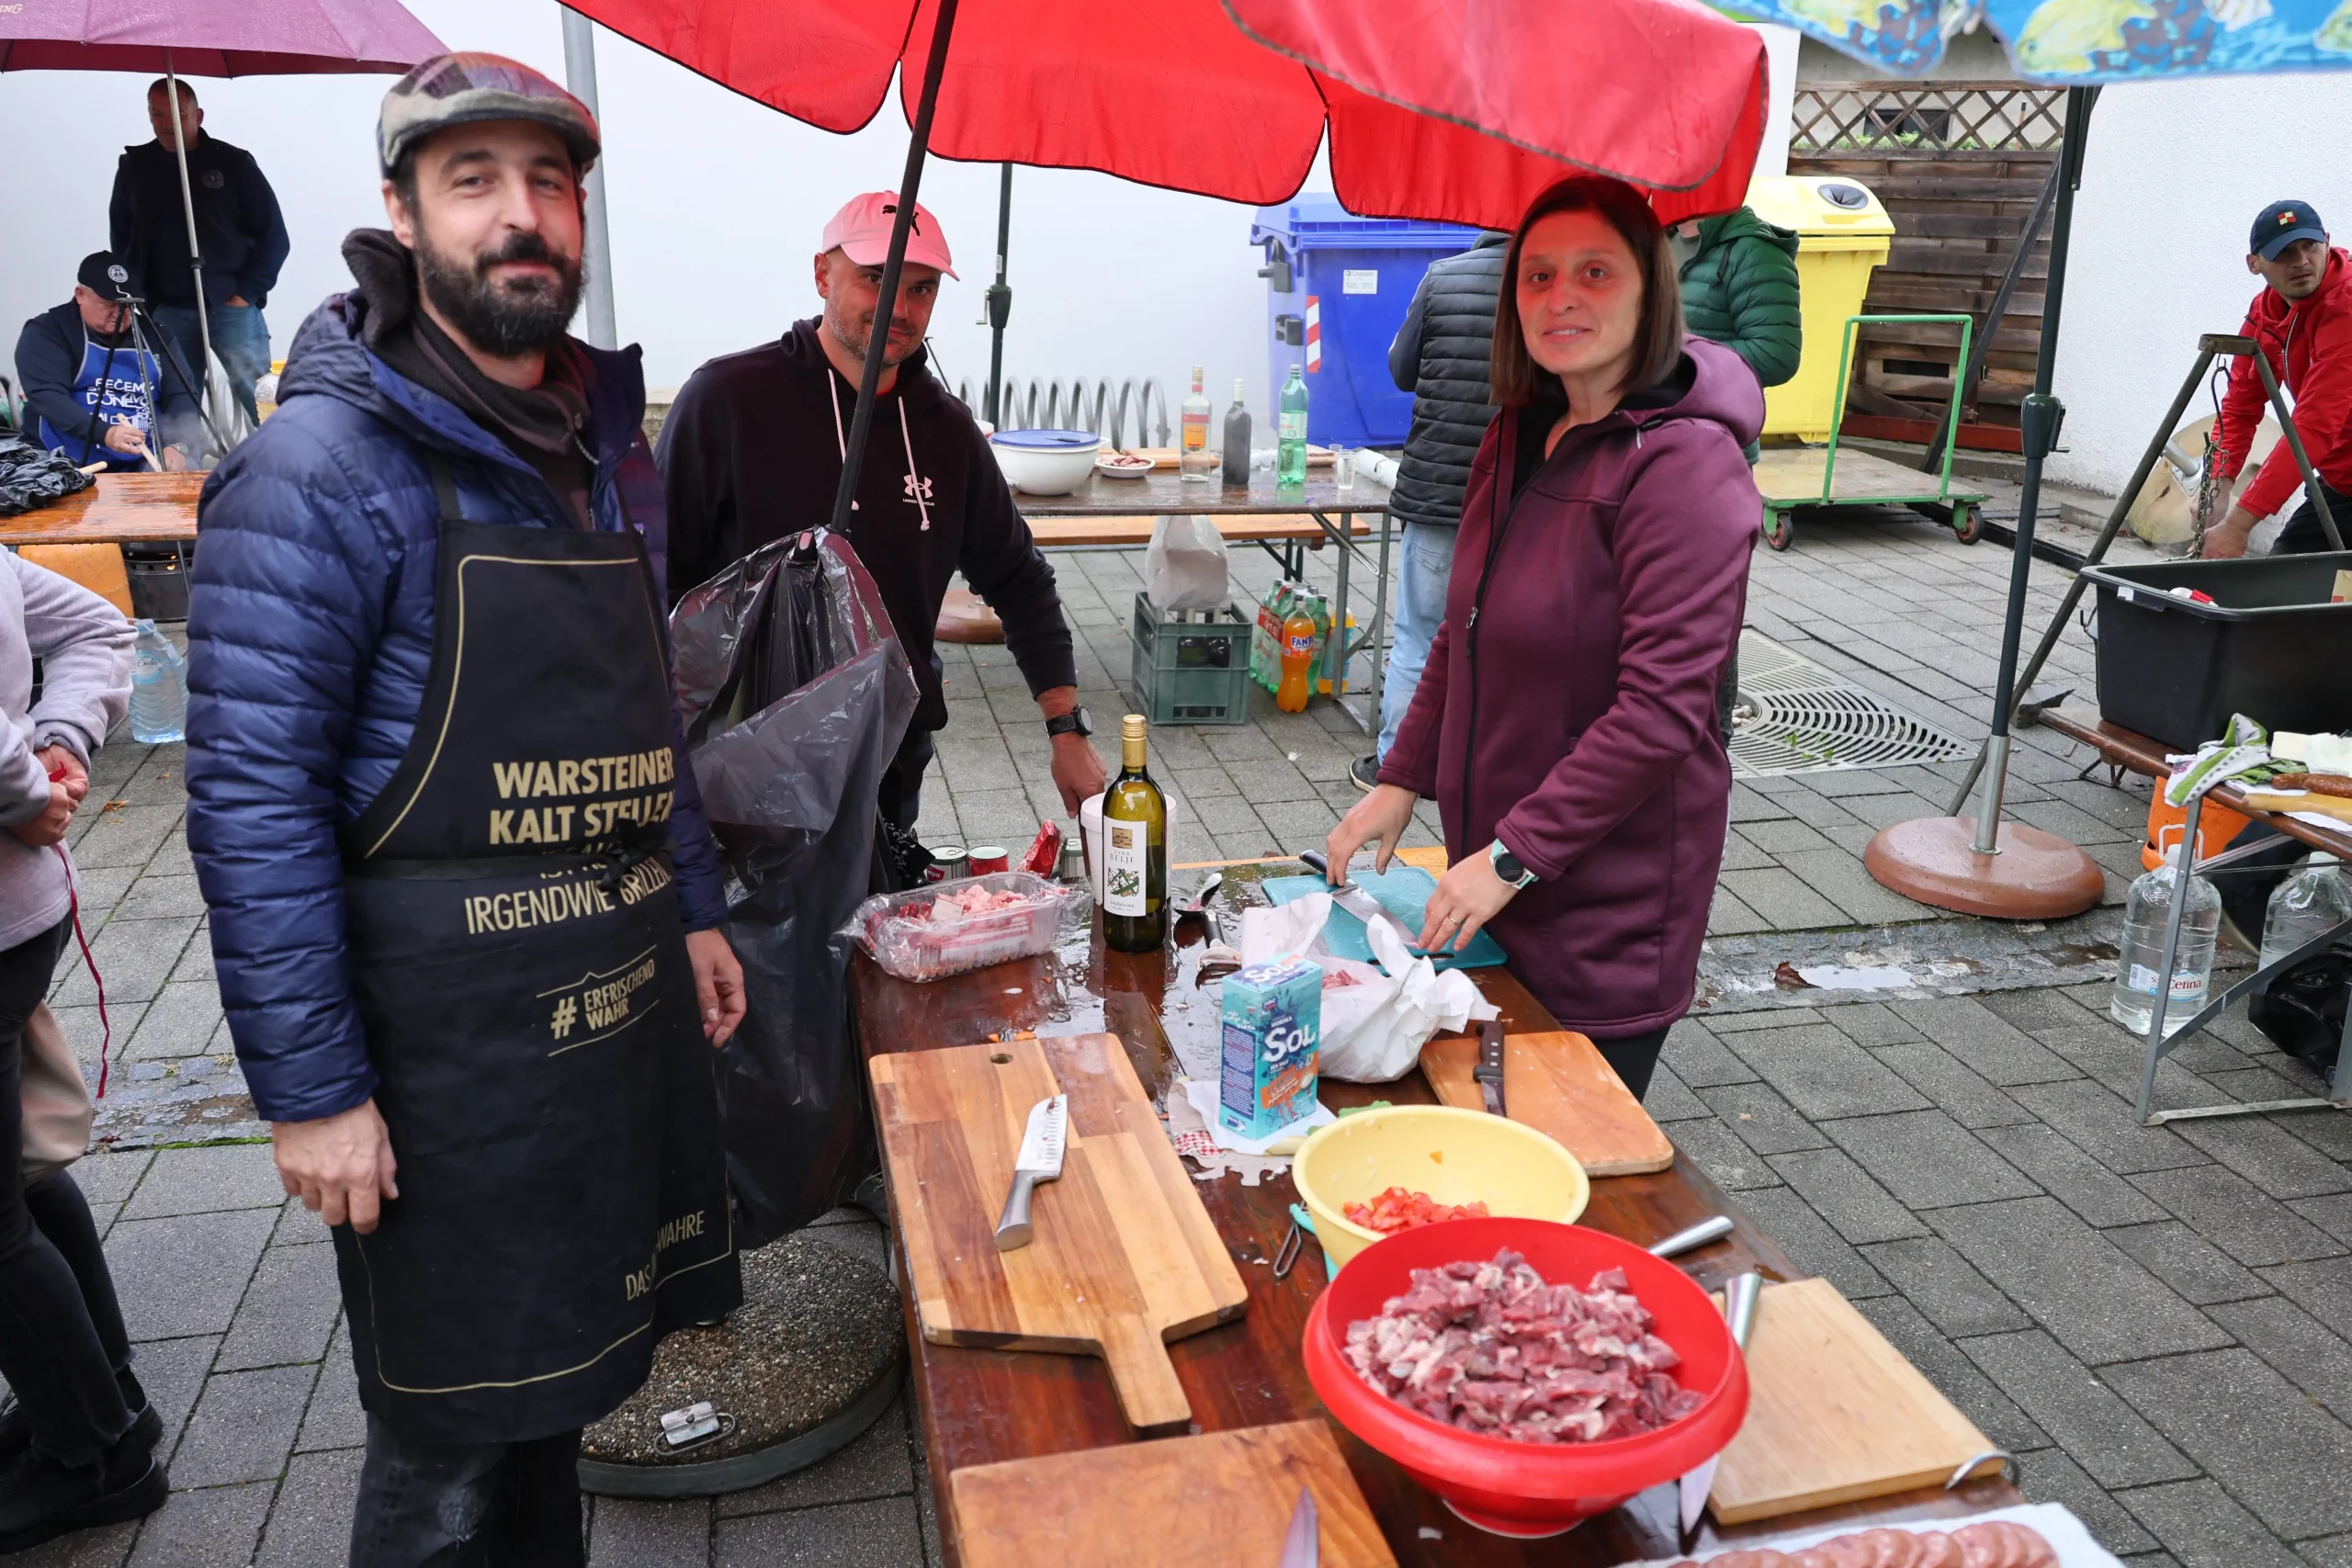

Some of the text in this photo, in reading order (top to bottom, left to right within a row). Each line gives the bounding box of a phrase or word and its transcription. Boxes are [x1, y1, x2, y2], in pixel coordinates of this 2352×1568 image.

[492, 746, 675, 799] WARSTEINER
[489, 805, 576, 845] KALT
[1109, 853, 1136, 864] BELJE
[464, 879, 616, 935] IRGENDWIE
[582, 958, 656, 1012] ERFRISCHEND
[585, 997, 629, 1032] WAHR
[626, 1210, 705, 1301] DAS WAHRE
